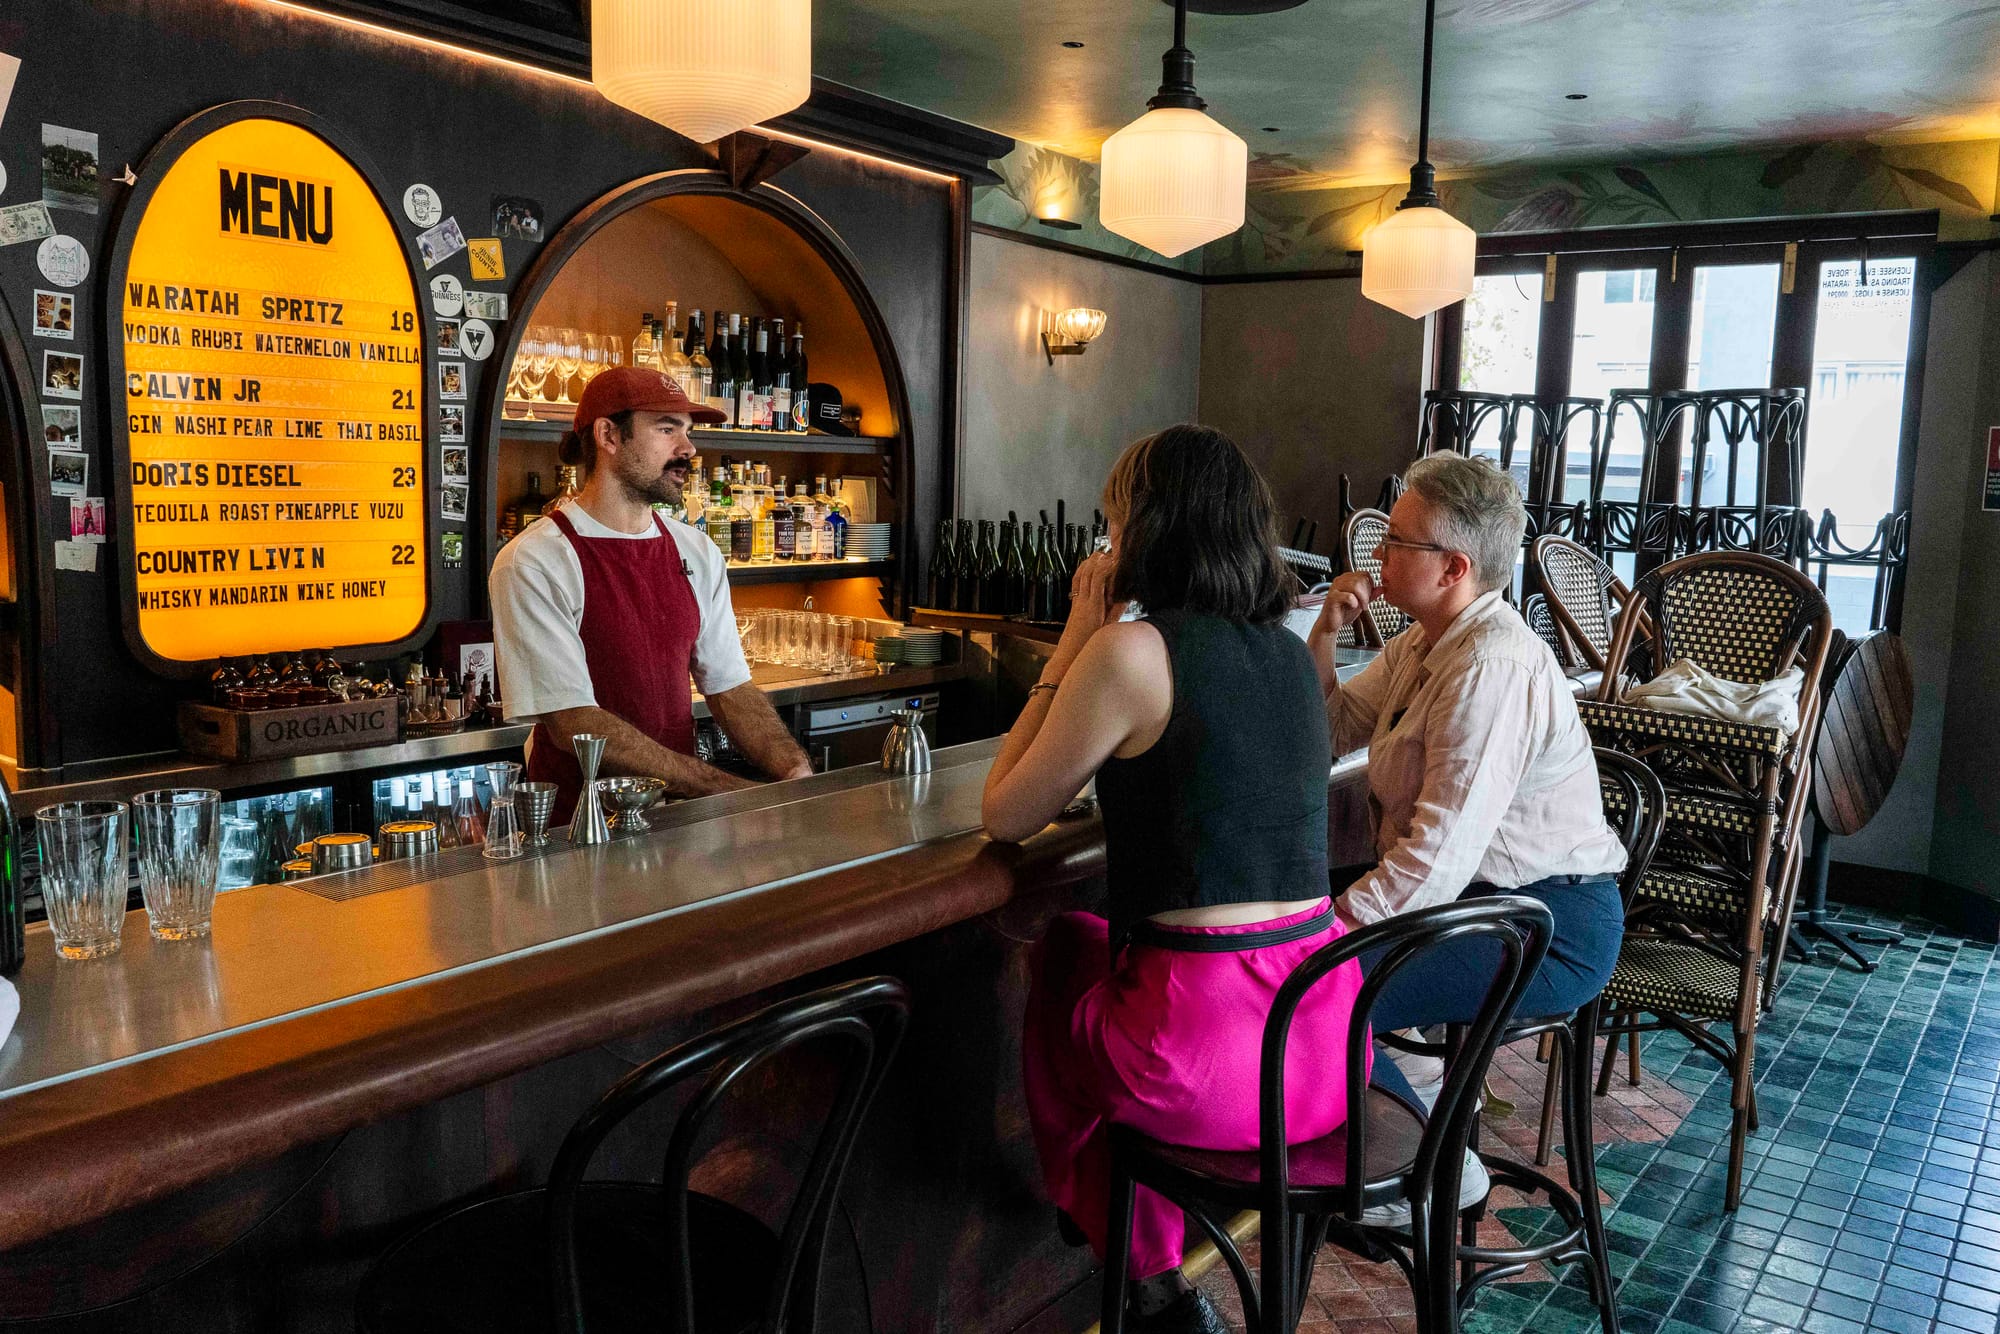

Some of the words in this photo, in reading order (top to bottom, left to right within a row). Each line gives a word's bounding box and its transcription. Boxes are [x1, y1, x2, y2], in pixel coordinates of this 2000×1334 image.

[219, 168, 333, 246] MENU
[471, 248, 499, 277] COUNTRY
[129, 283, 239, 316] WARATAH
[262, 296, 344, 326] SPRITZ
[391, 309, 414, 333] 18
[125, 323, 181, 346] VODKA
[191, 328, 244, 350] RHUBI
[255, 333, 351, 359] WATERMELON
[359, 342, 420, 365] VANILLA
[128, 373, 221, 401] CALVIN
[233, 379, 261, 403] JR
[392, 389, 416, 410] 21
[129, 414, 162, 434] GIN
[175, 416, 227, 436] NASHI
[233, 418, 273, 437] PEAR
[285, 419, 323, 439] LIME
[337, 422, 373, 441] THAI
[378, 424, 421, 442] BASIL
[132, 462, 209, 487] DORIS
[216, 463, 302, 488] DIESEL
[392, 467, 416, 488] 23
[134, 503, 209, 523] TEQUILA
[220, 503, 270, 522] ROAST
[275, 502, 360, 521] PINEAPPLE
[369, 502, 404, 520] YUZU
[137, 549, 240, 575] COUNTRY
[391, 544, 415, 565] 22
[139, 588, 202, 610] WHISKY
[209, 584, 288, 606] MANDARIN
[297, 582, 335, 601] WINE
[342, 580, 386, 599] HONEY
[263, 710, 386, 743] ORGANIC
